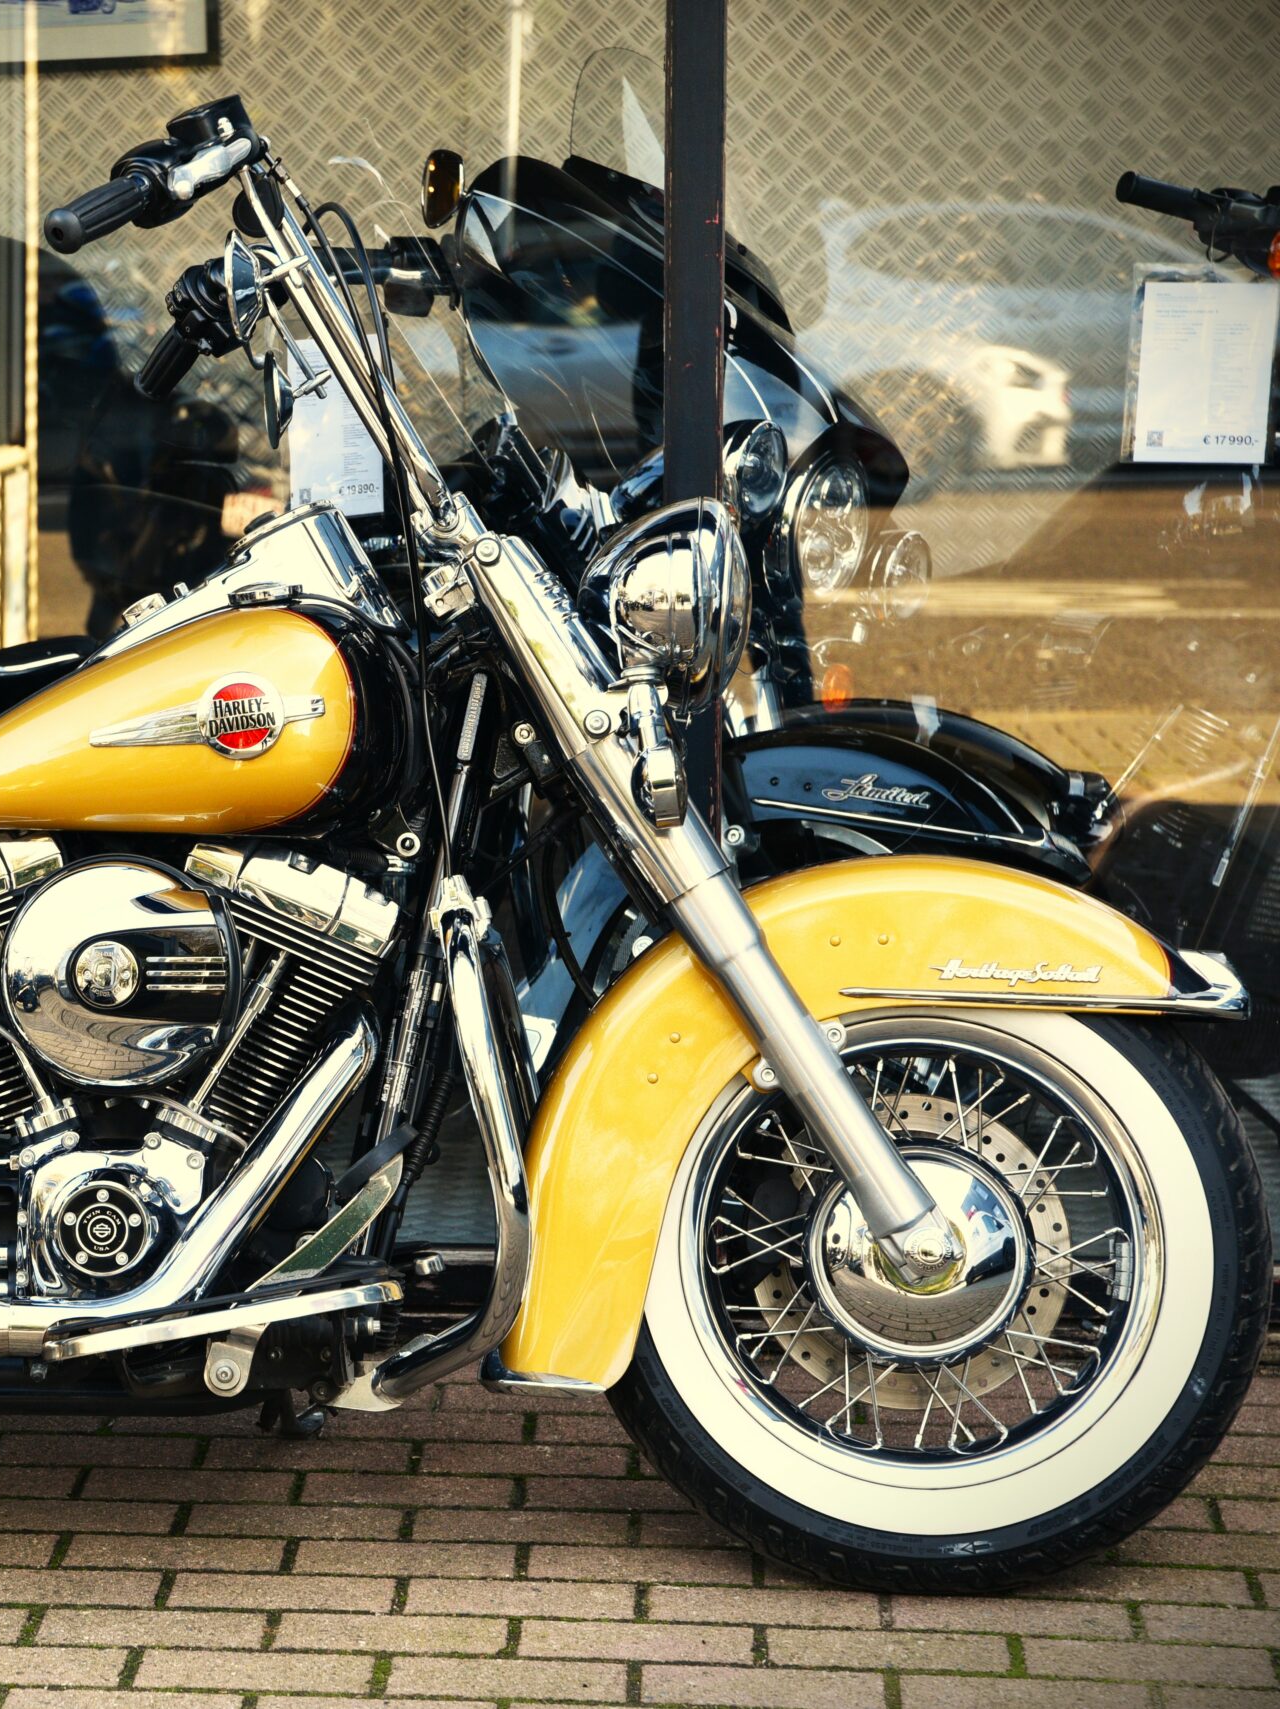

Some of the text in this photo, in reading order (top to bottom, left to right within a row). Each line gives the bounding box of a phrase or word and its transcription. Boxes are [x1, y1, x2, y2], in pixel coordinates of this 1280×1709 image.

[213, 697, 270, 719] HARLEY-
[209, 711, 276, 738] DAVIDSON
[821, 773, 931, 810] Limited
[928, 959, 1104, 988] Heritage Softail
[83, 1209, 122, 1226] TWIN CAM
